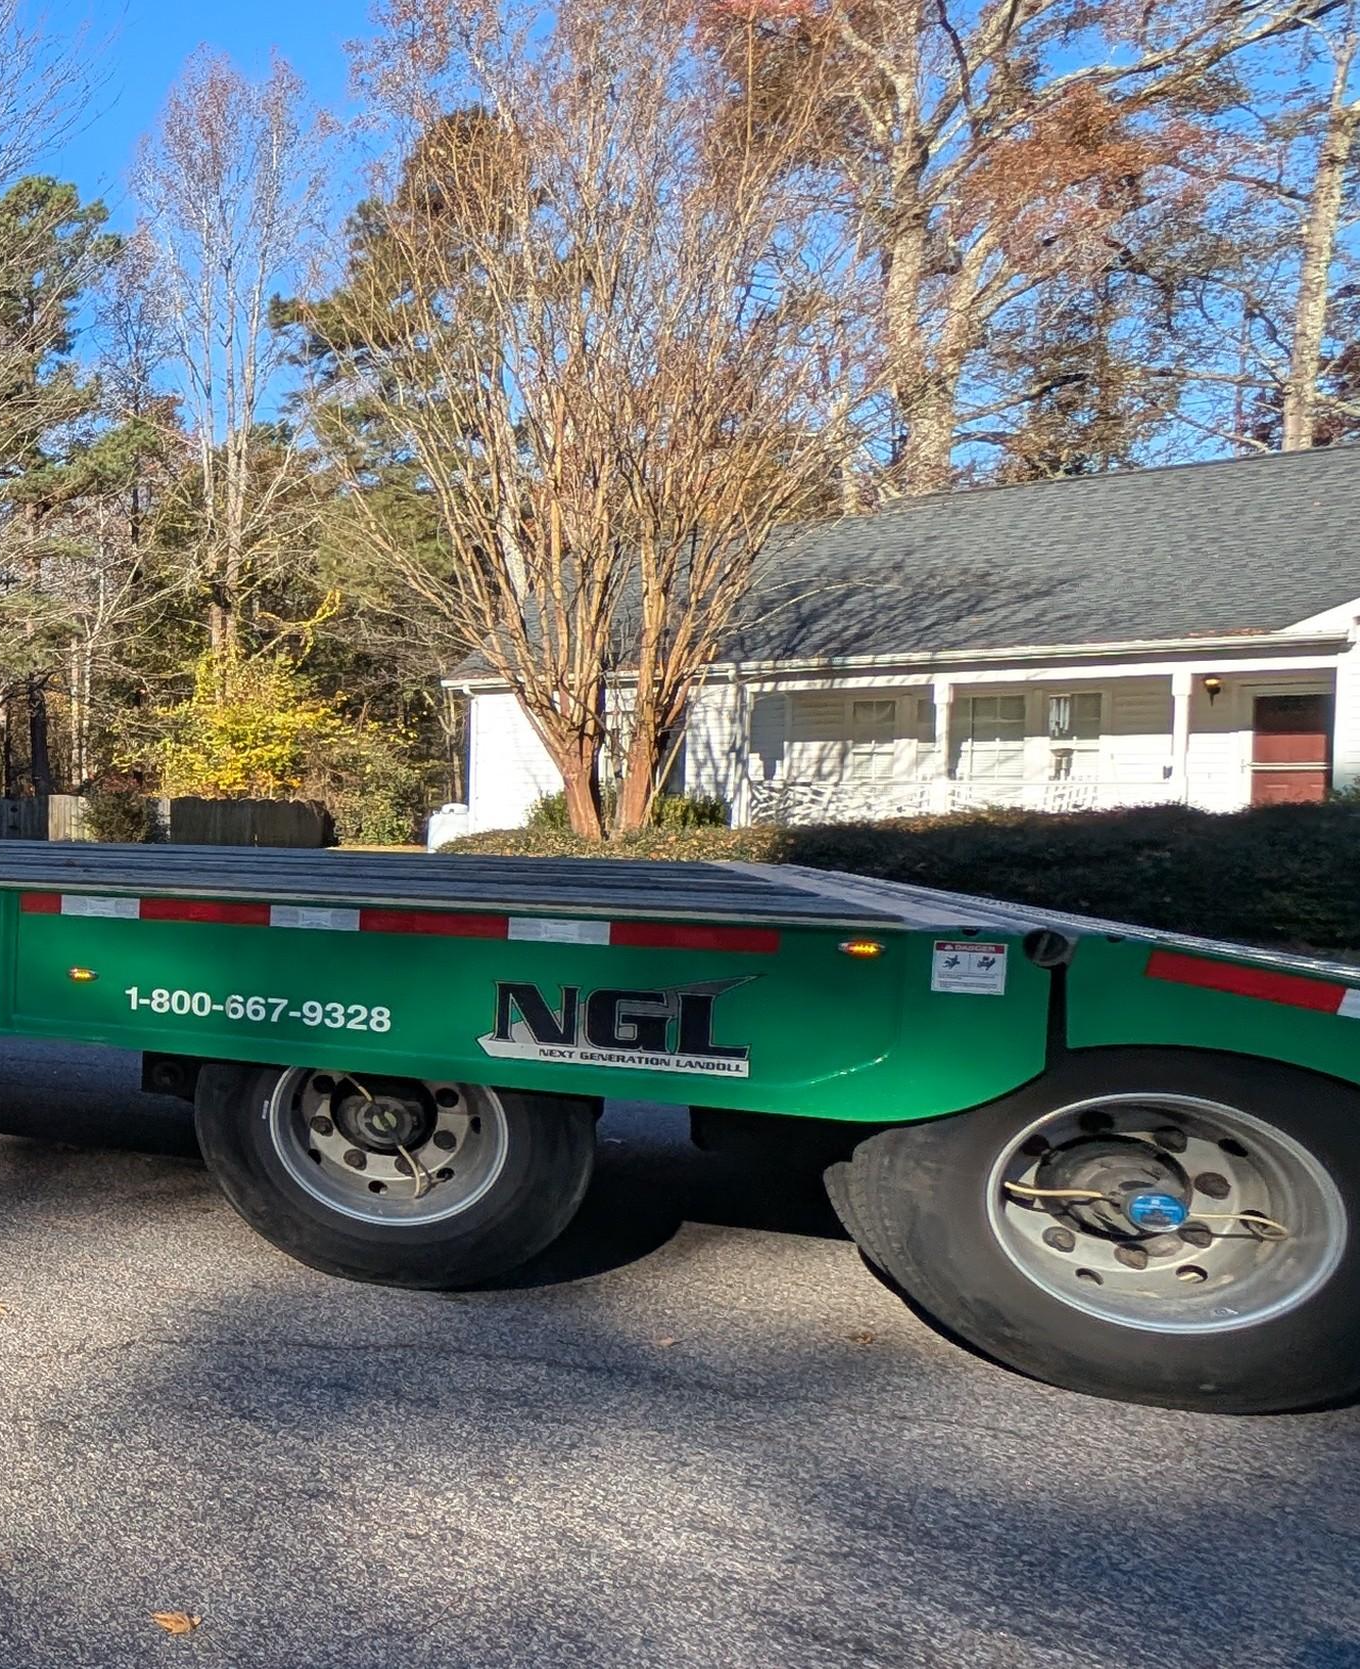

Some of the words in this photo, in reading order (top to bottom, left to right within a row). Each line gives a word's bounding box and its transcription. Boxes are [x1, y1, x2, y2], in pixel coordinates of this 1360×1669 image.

[125, 986, 392, 1032] 1-800-667-9328
[491, 980, 751, 1060] NGL
[538, 1048, 575, 1059] NEXT
[580, 1051, 671, 1067] GENERATION
[676, 1060, 744, 1072] LANDOLL
